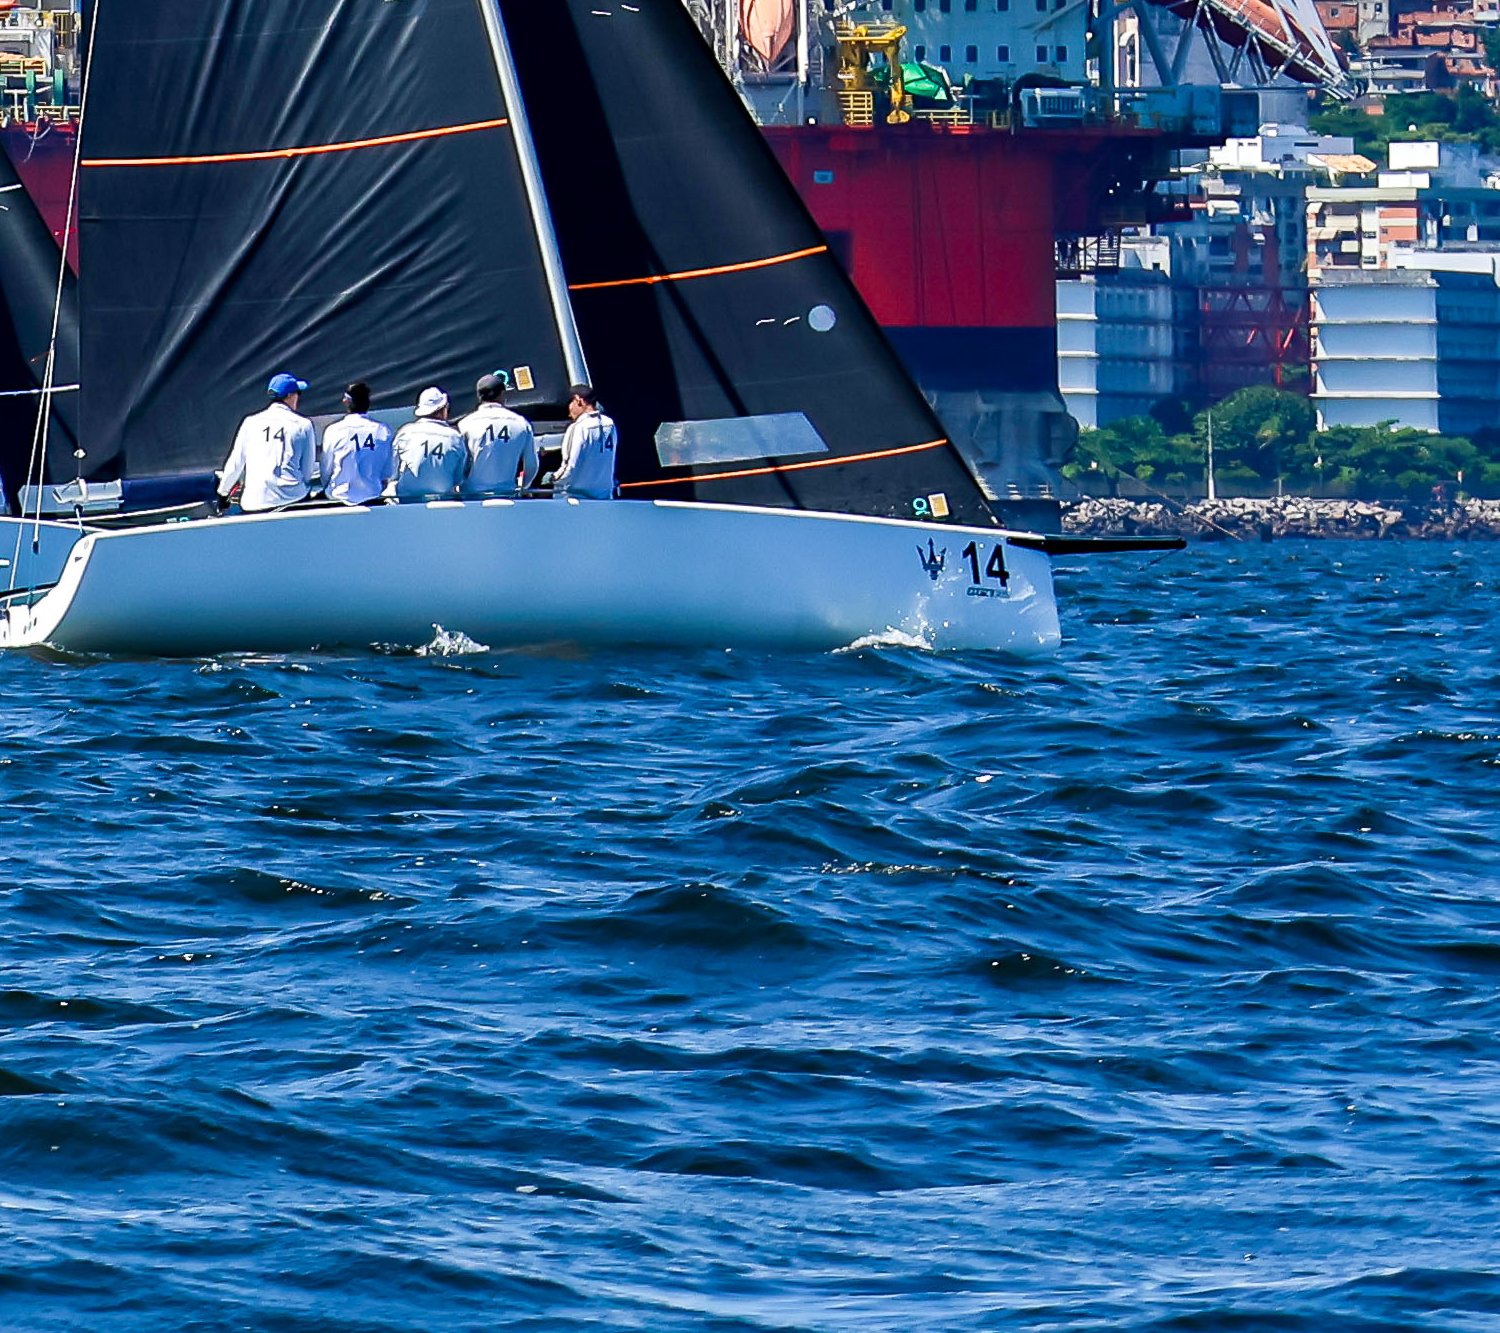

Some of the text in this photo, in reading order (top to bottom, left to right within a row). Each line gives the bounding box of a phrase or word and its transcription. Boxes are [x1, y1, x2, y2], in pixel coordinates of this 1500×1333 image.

[262, 426, 286, 442] 14
[350, 433, 376, 451] 14
[485, 424, 510, 443] 14
[420, 440, 445, 459] 14
[962, 540, 1010, 587] 14
